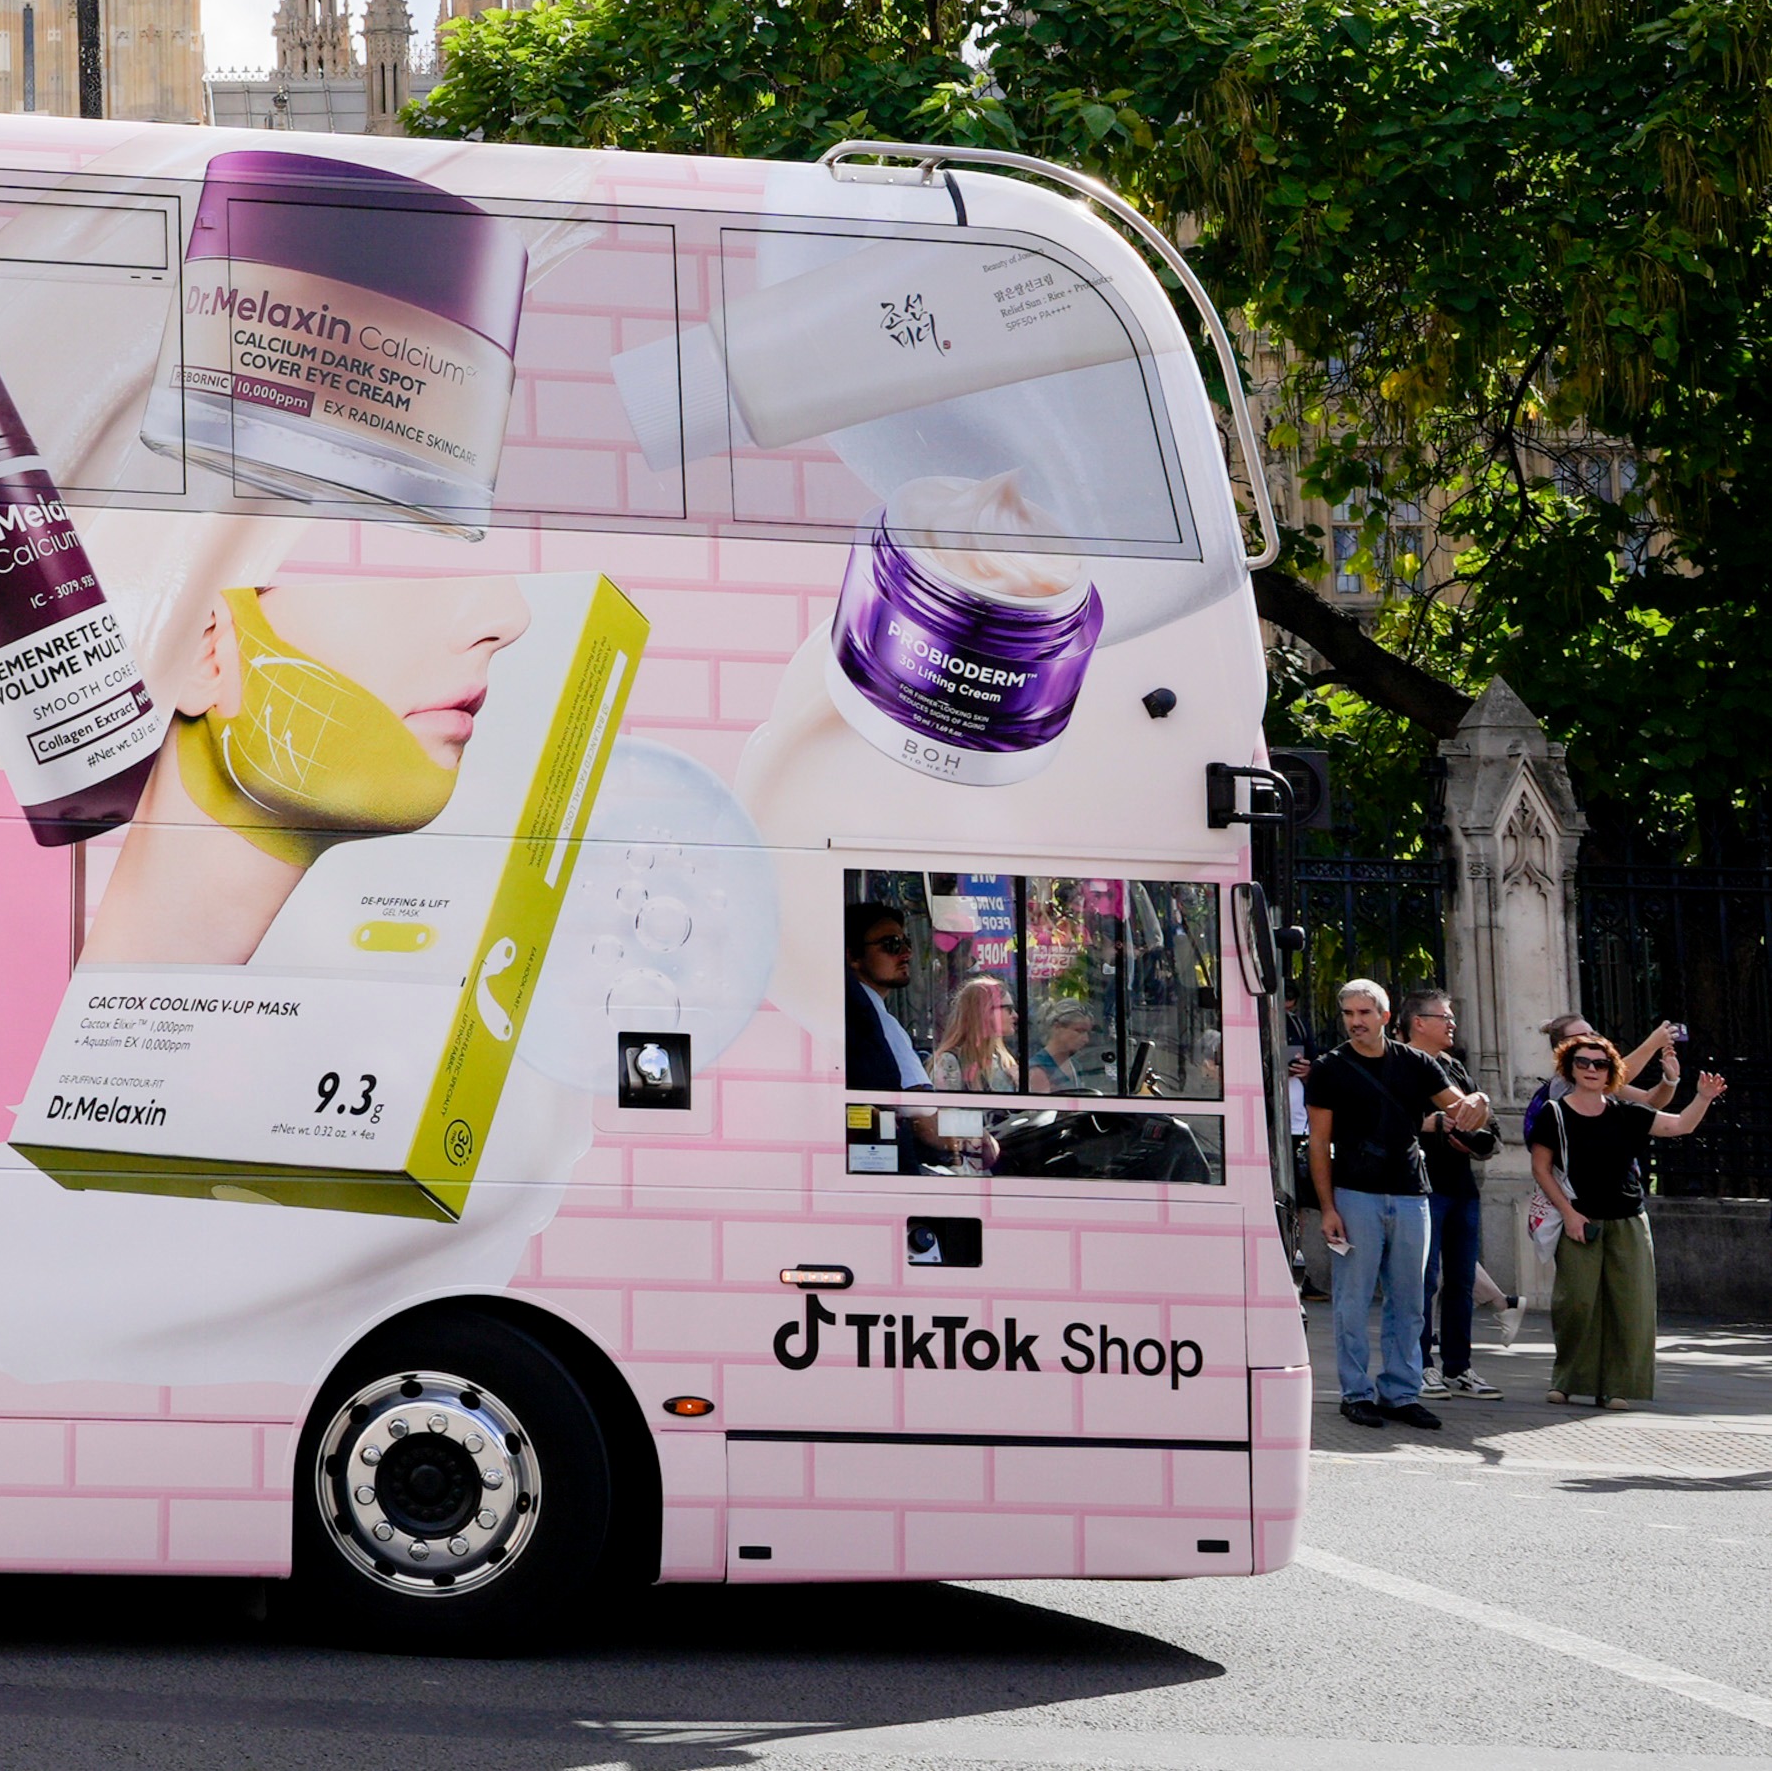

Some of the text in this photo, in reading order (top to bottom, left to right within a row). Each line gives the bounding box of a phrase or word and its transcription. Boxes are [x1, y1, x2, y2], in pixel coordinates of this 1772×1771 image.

[999, 297, 1042, 318] Relief Sun
[186, 285, 465, 386] Dr.Melaxin Calcium
[233, 329, 427, 396] CALCIUM DARK SPOT
[236, 379, 309, 410] 10,000ppm
[240, 351, 412, 412] COVER EYE CREAM
[323, 400, 479, 466] EX RADIANCE SKINCARE
[899, 655, 1002, 703] 3D Lifting Cream
[33, 682, 102, 721] SMOOTH
[37, 700, 135, 754] Collagen Extract
[903, 738, 962, 769] BOH
[361, 895, 450, 909] DE-PUFFING LIFT
[88, 996, 301, 1017] CACTOX COOLING V-UP MASK
[80, 1017, 111, 1030] Cactox
[81, 1035, 139, 1050] Aquaslim EX
[58, 1074, 165, 1089] DE-PUFFING CONTOUR-FIT
[46, 1094, 168, 1127] Dr.Melaxin
[845, 1313, 1203, 1390] TikTok Shop
